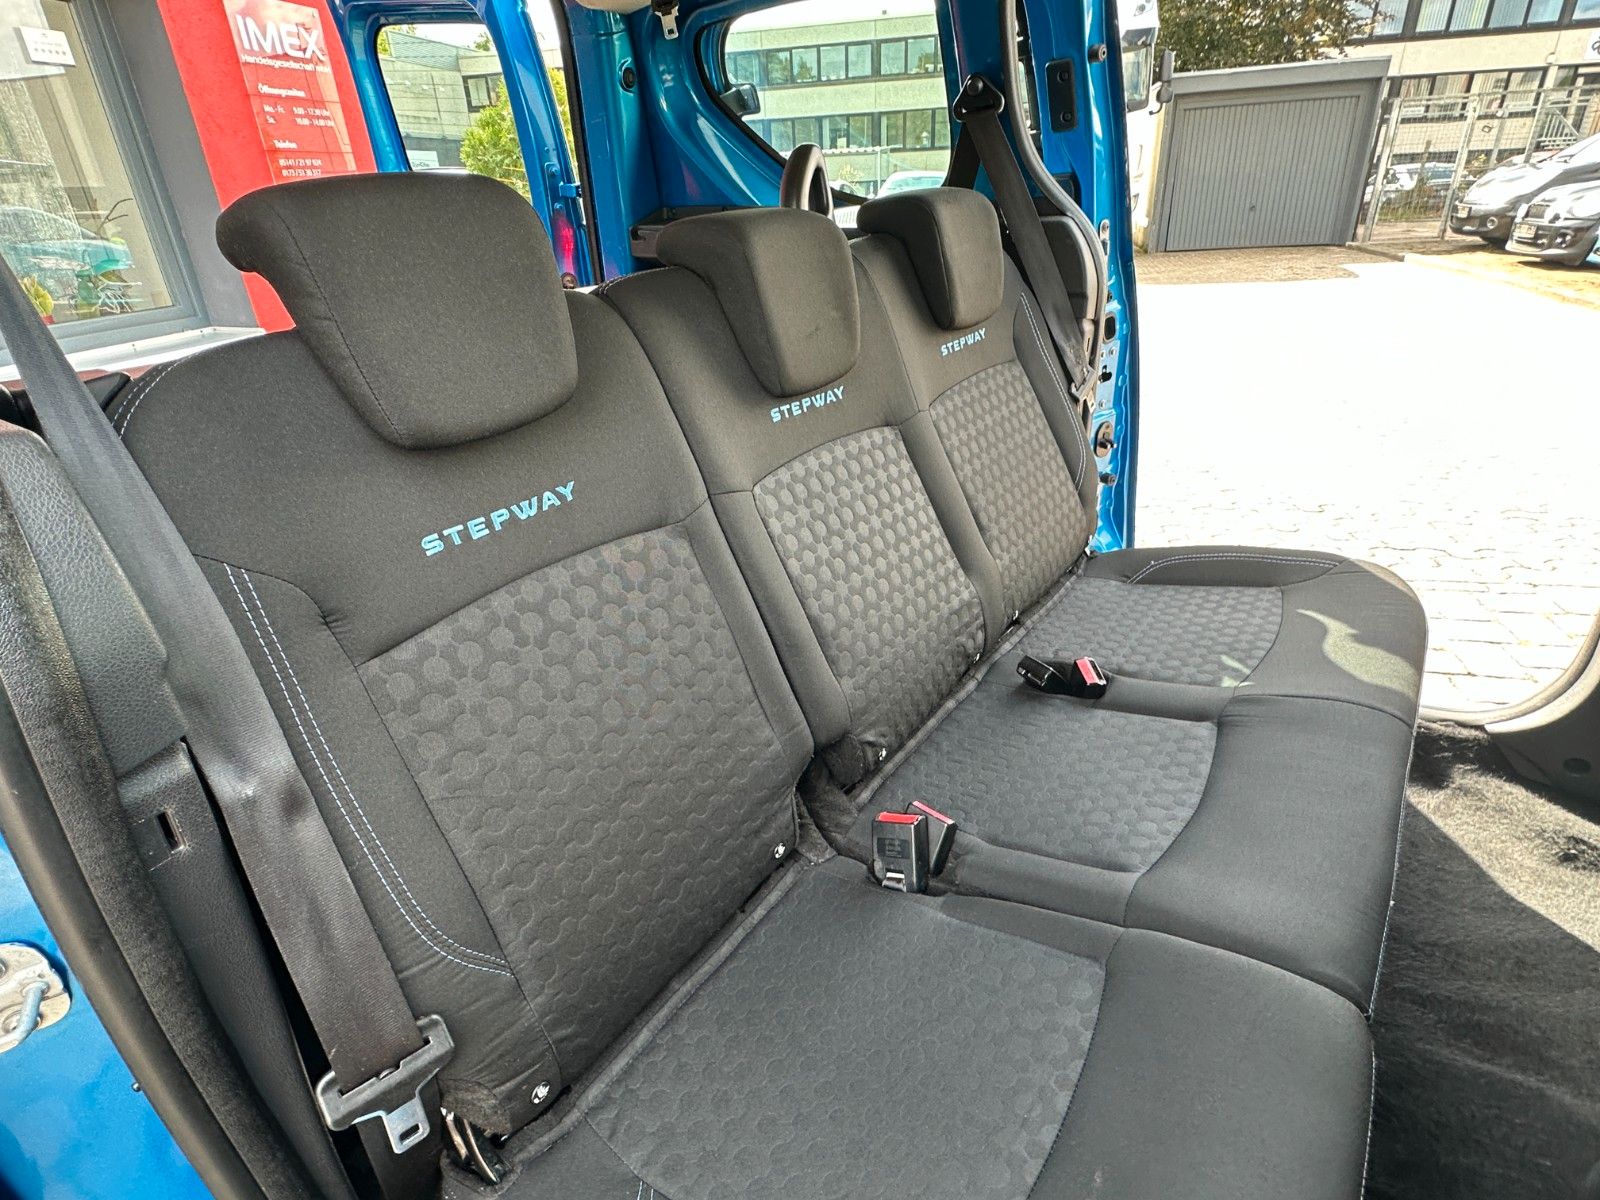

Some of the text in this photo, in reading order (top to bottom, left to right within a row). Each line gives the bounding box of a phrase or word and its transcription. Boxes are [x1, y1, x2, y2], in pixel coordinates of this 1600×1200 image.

[235, 14, 326, 62] IMEX
[940, 328, 987, 357] STEPWAY
[770, 385, 844, 423] STEPWAY
[420, 480, 575, 557] STEPWAY
